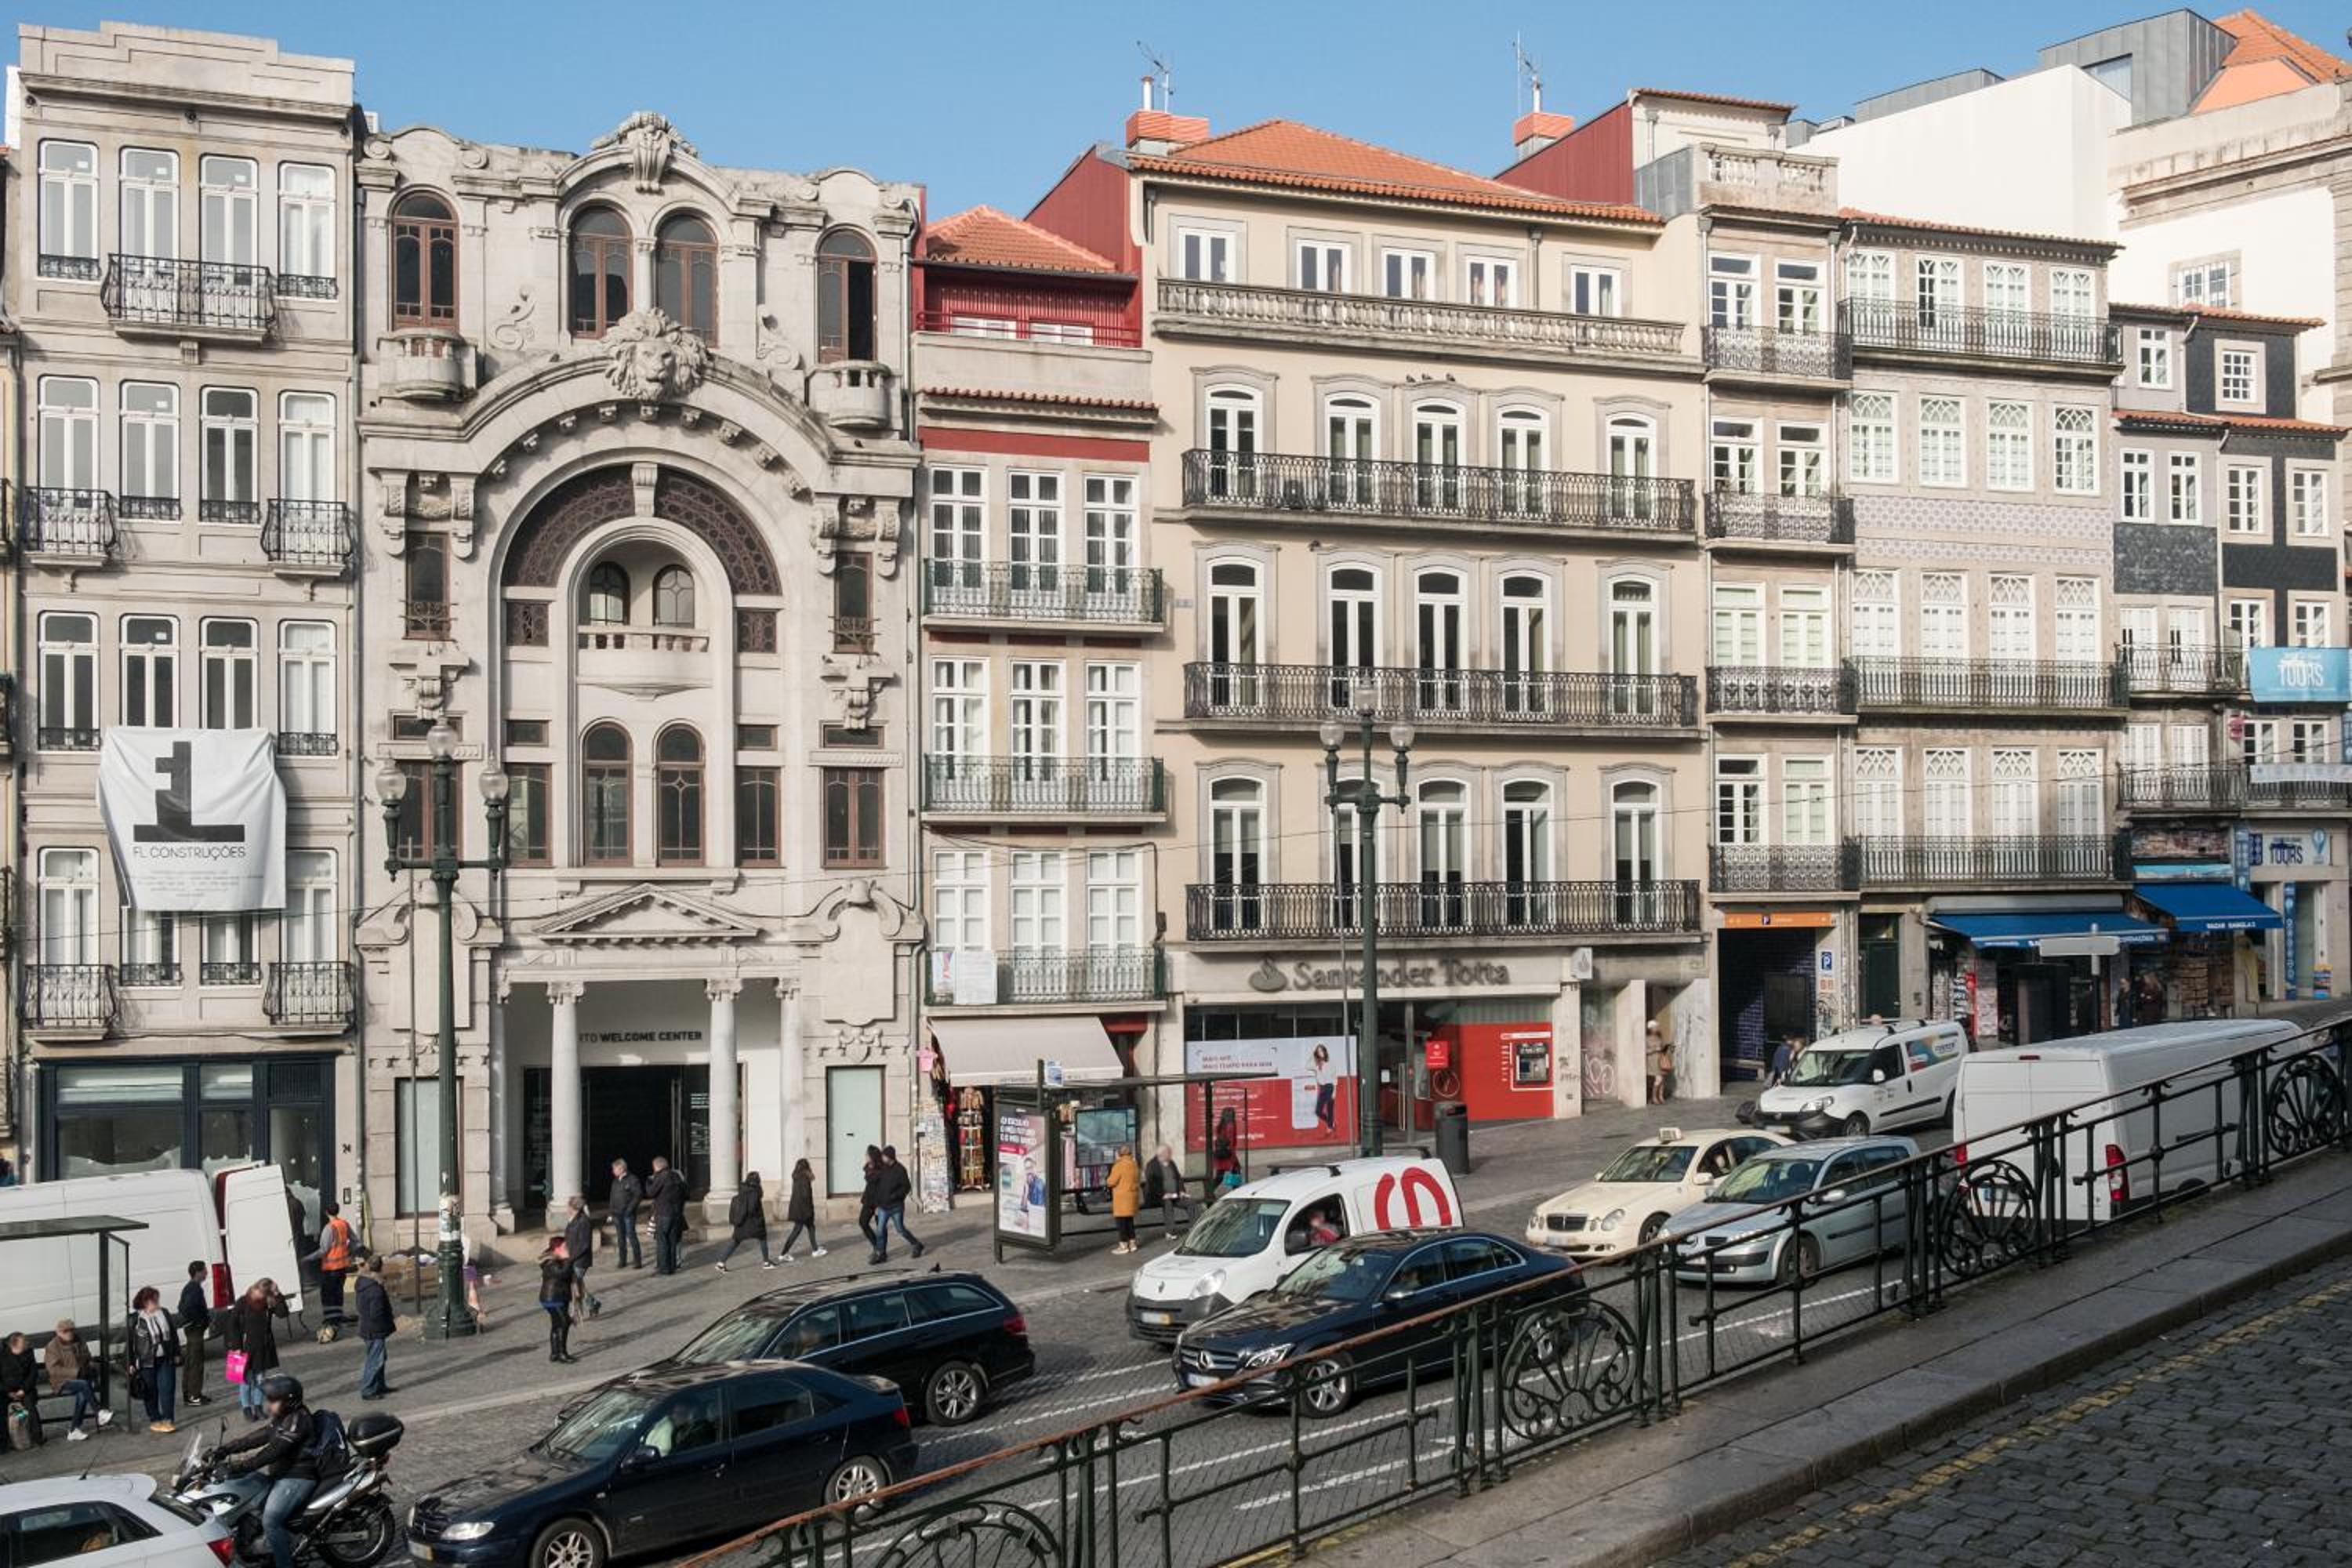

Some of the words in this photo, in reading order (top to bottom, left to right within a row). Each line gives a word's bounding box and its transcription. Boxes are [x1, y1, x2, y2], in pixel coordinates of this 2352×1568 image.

[2277, 664, 2324, 687] TOURS
[133, 847, 147, 858] FL
[150, 844, 246, 861] CONSTRUÇÕES
[2270, 844, 2303, 864] TOURS
[1439, 957, 1511, 985] Totta
[601, 1032, 656, 1043] WELCOME
[659, 1030, 702, 1042] CENTER
